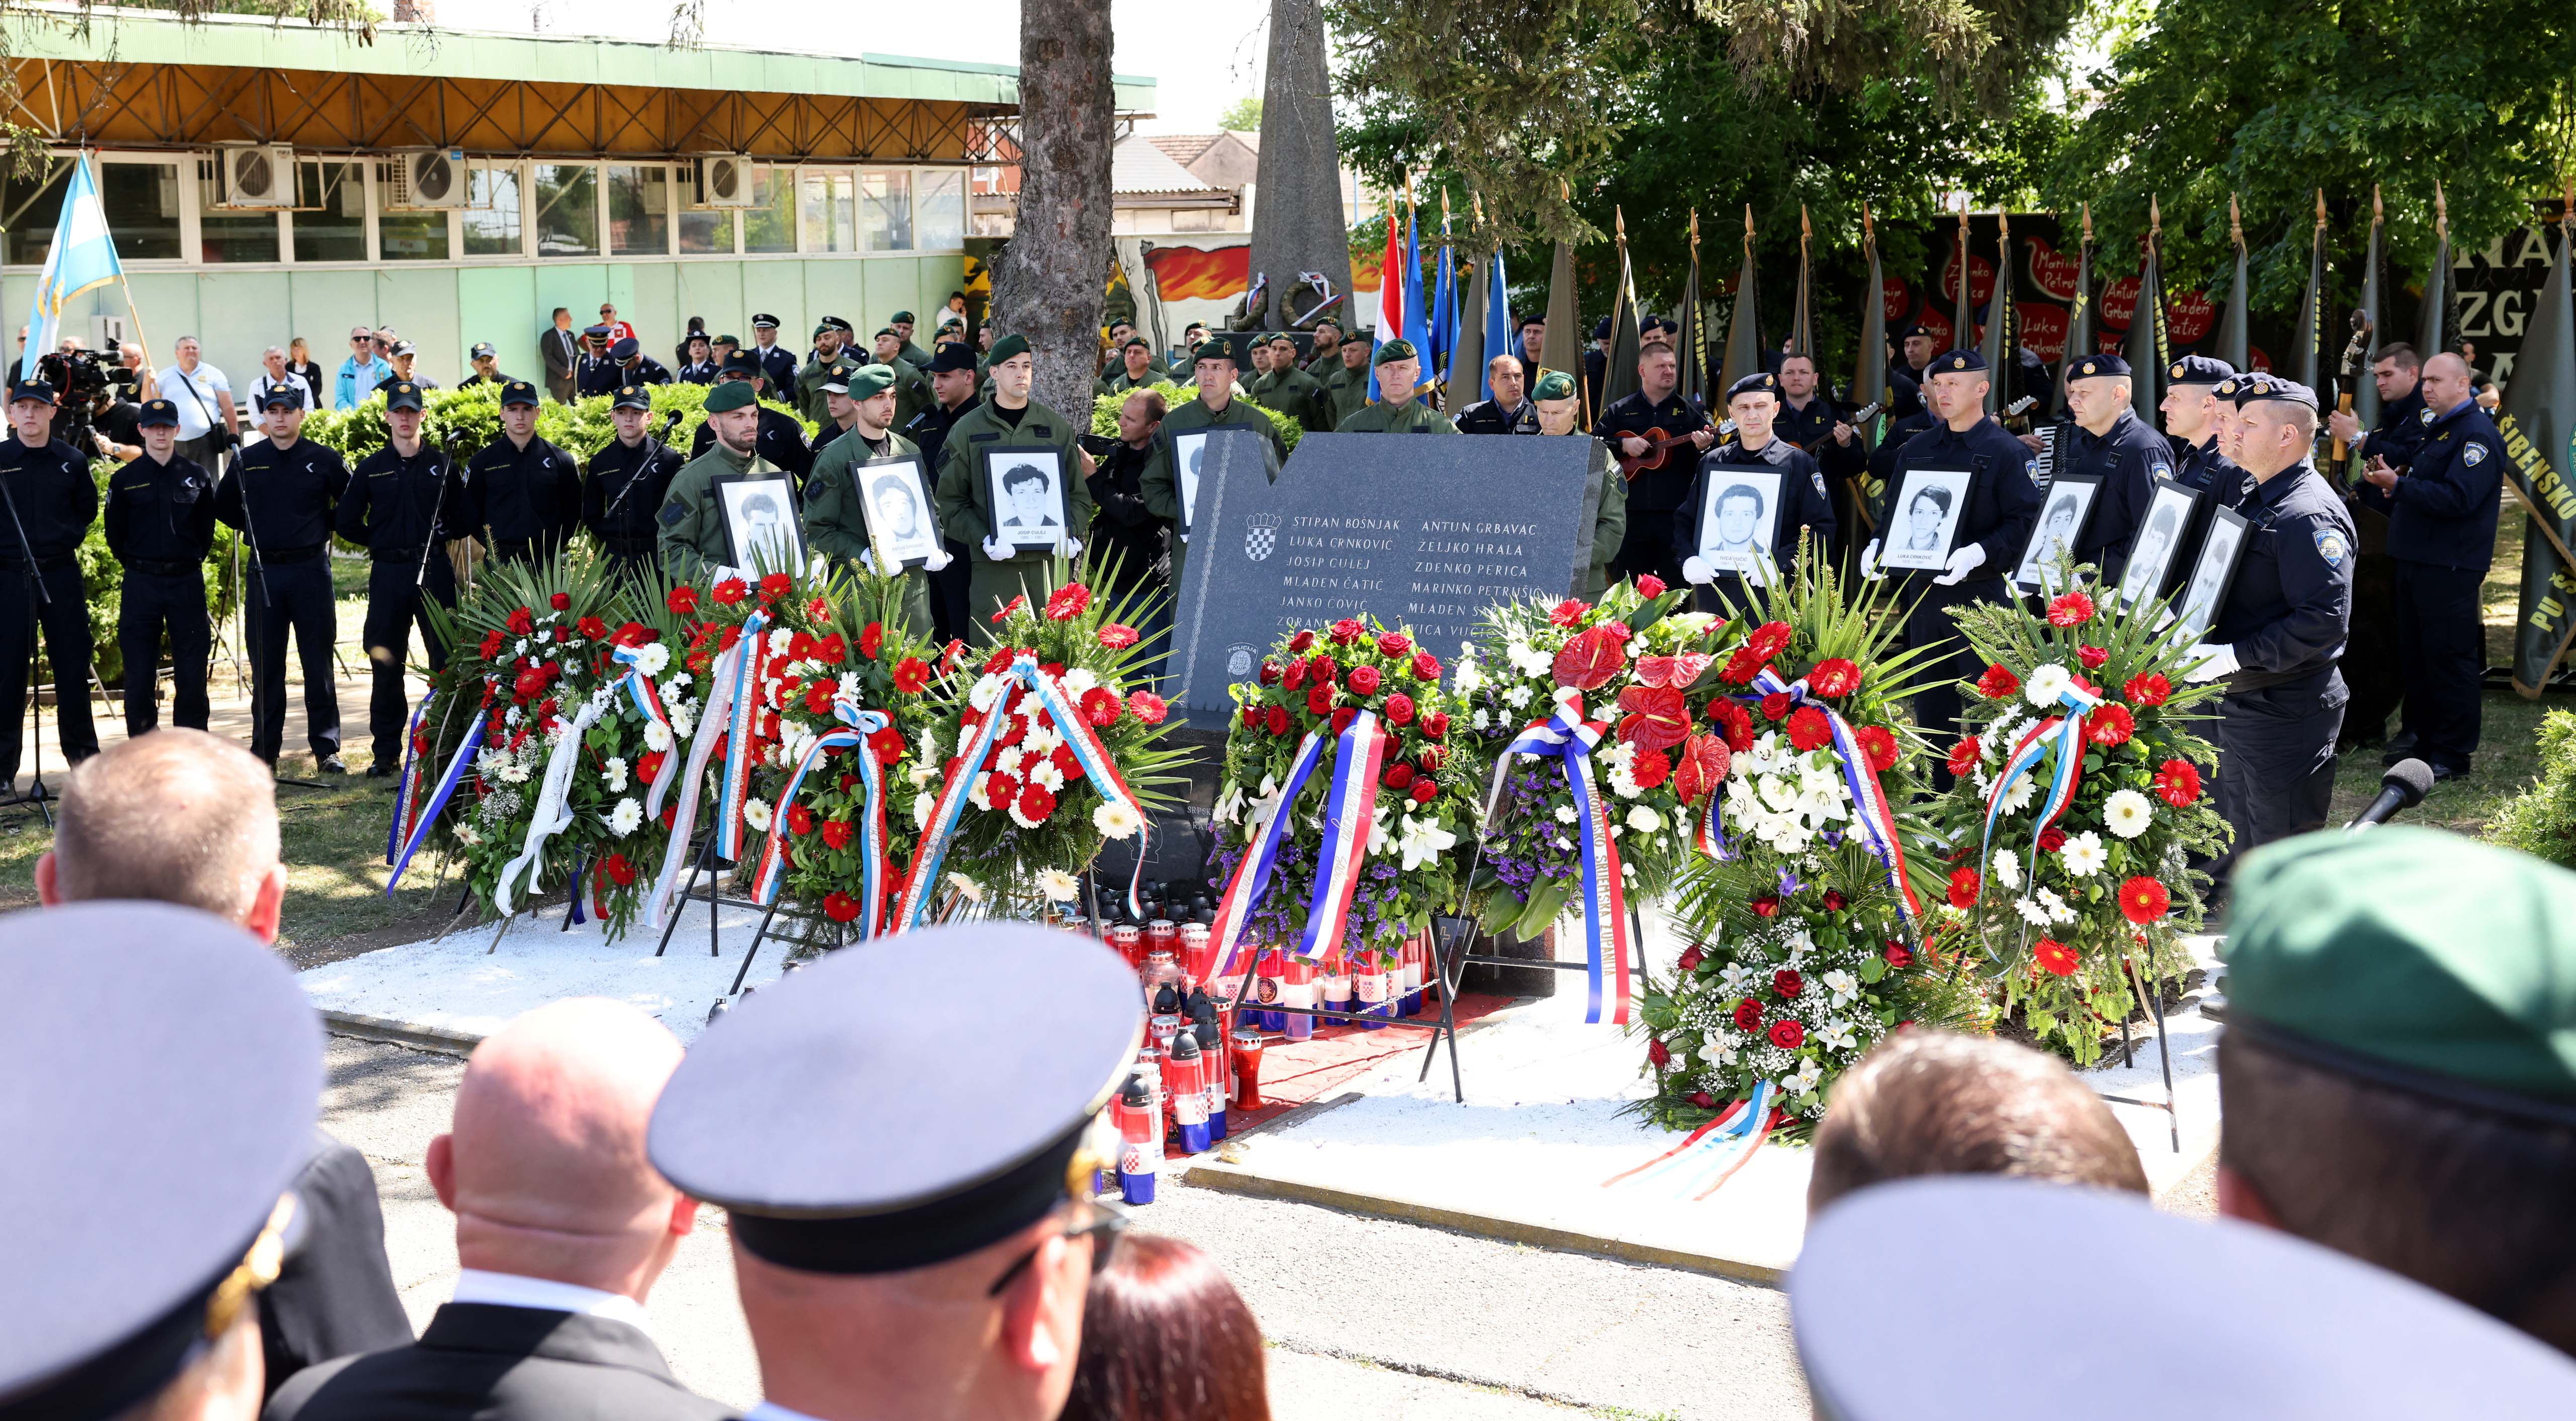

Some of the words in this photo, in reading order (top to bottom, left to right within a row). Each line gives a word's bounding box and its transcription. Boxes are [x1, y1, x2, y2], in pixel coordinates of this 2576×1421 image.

[2024, 317, 2058, 333] Luka
[1293, 516, 1340, 528] STIPAN
[1346, 516, 1400, 530] BOŠNJAK
[1421, 520, 1470, 533] ANTUN
[1476, 523, 1537, 535] GRBAVAC
[1290, 536, 1323, 548] LUKA
[1330, 537, 1393, 550] CRNKOVIĆ
[1418, 539, 1469, 554] ŽELJKO
[1475, 543, 1522, 556] HRALA
[1286, 557, 1324, 568] JOSIP
[1329, 558, 1371, 569] CULEJ
[1415, 562, 1471, 574] ZDENKO
[1477, 565, 1527, 577] PERICA
[1283, 576, 1338, 588] MLADEN
[1344, 576, 1383, 591] ČATIĆ
[1411, 582, 1471, 595] MARINKO
[1280, 596, 1322, 607] JANKO
[1327, 596, 1368, 610] ČOVIĆ
[1408, 603, 1465, 616] MLADEN
[2529, 596, 2564, 632] PU
[1277, 616, 1322, 628] ZORAN
[1228, 646, 1257, 654] POLICIJA
[732, 693, 753, 759] REPUBLIKE
[725, 767, 744, 829] HRVATSKE
[1583, 776, 1608, 848] VUKOVARSKO
[869, 820, 885, 865] POKRET
[1595, 853, 1613, 918] SRIJEMSKA
[1600, 922, 1619, 978] ŽUPANIJA
